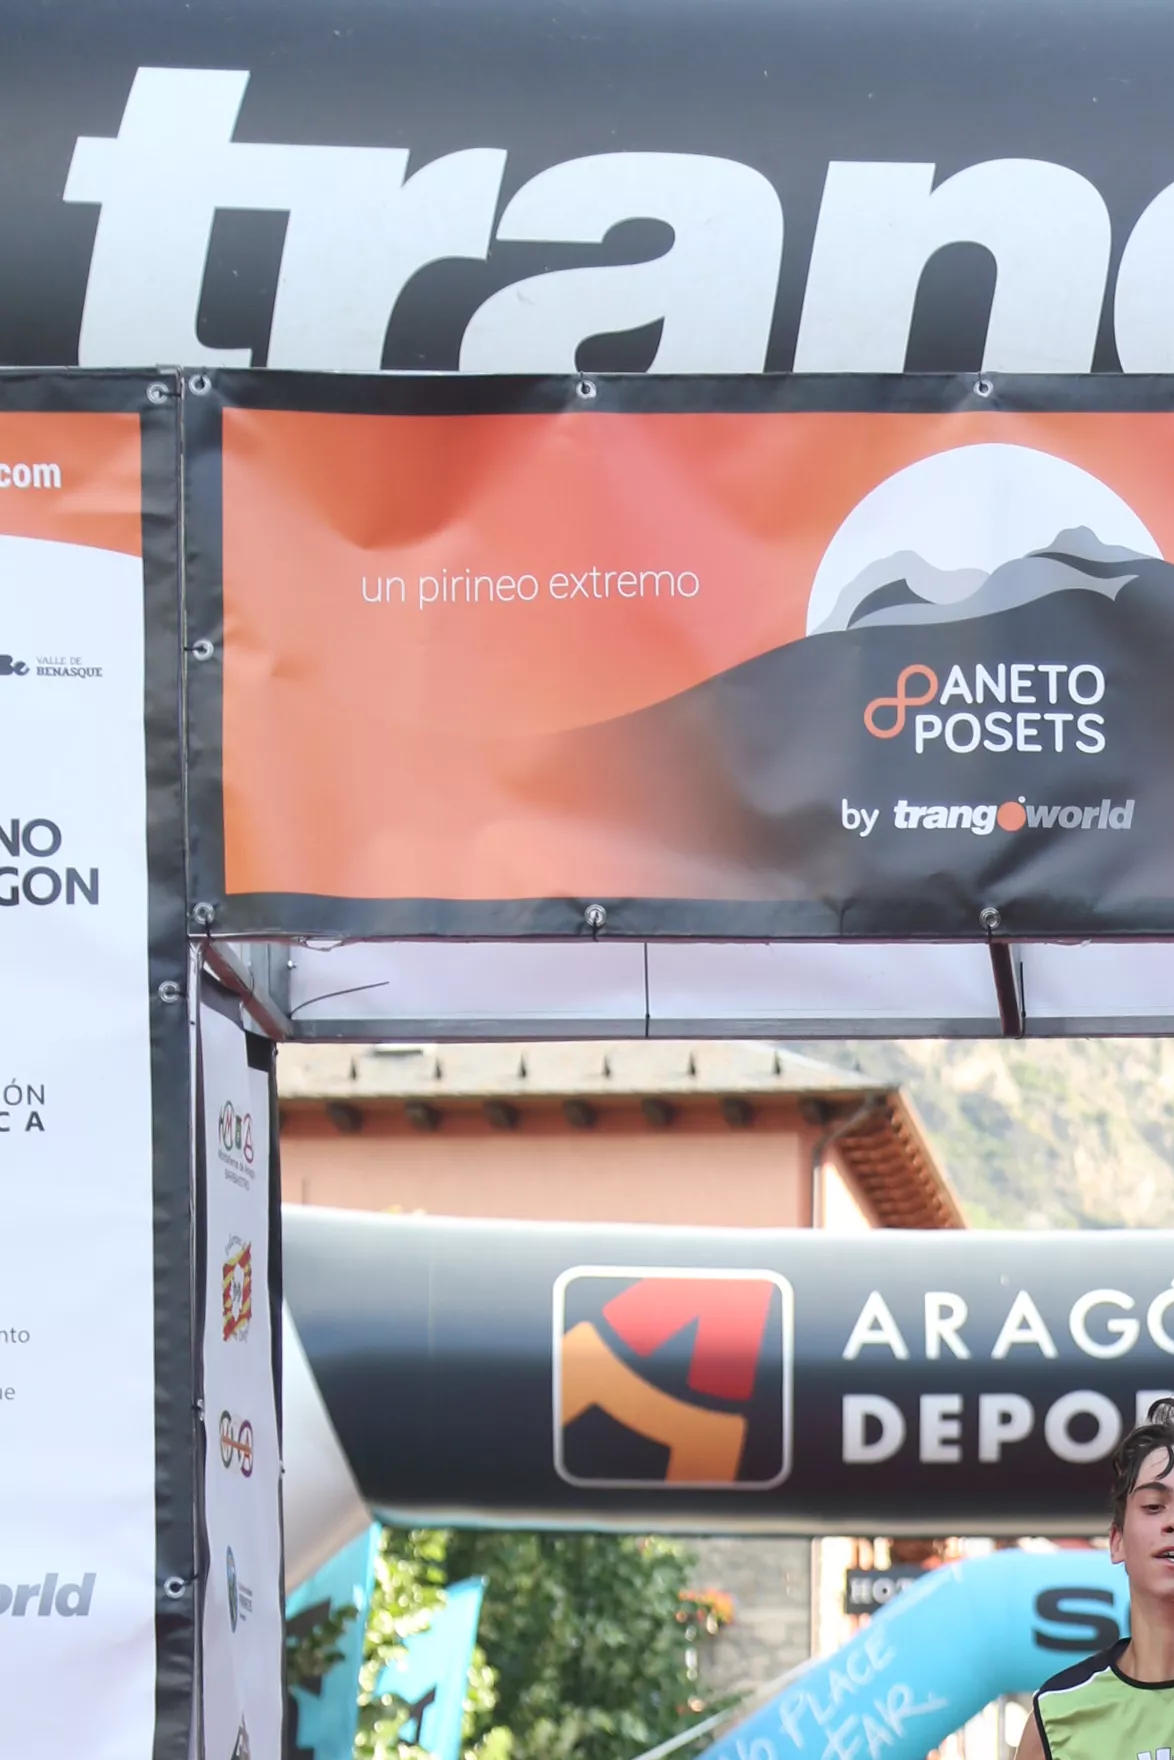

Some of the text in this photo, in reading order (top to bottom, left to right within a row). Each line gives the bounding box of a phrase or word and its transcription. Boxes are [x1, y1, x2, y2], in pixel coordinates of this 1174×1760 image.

[361, 565, 700, 609] un pirineo extremo
[36, 656, 82, 666] VALLE DE
[36, 666, 103, 678] BENASQUE
[940, 663, 1105, 705] ANETO
[915, 713, 1105, 754] POSETS
[842, 798, 1135, 837] by trangoworld
[779, 1626, 896, 1751] PLACE
